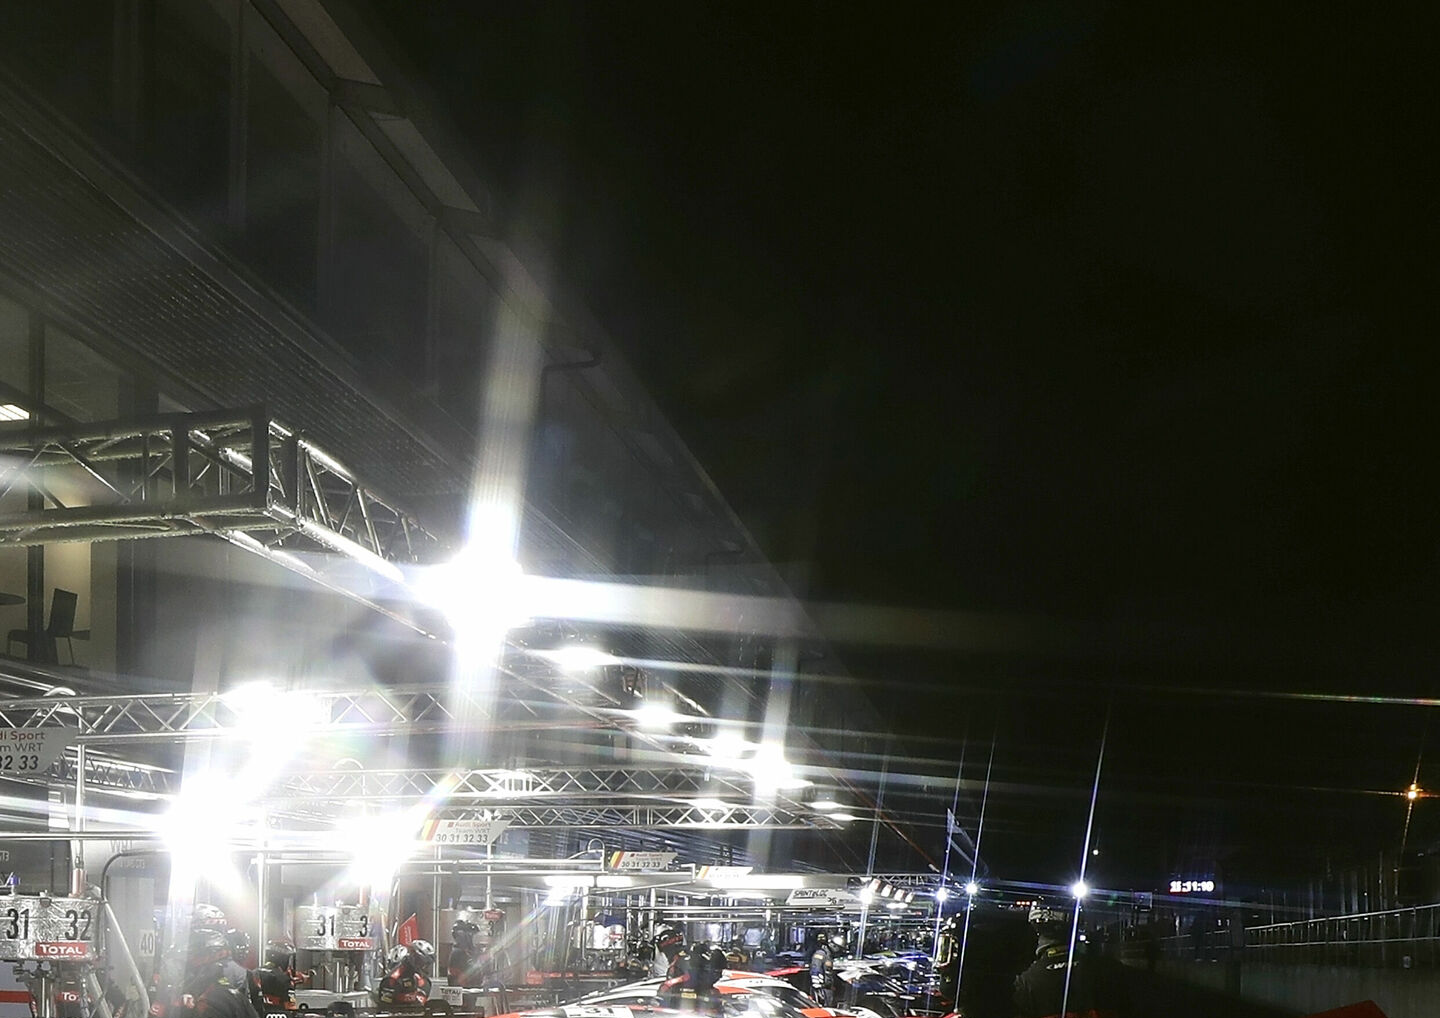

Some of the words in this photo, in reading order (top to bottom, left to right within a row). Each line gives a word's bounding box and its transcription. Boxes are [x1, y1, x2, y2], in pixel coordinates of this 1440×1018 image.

[10, 730, 45, 742] Sport
[14, 743, 43, 752] WRT
[18, 754, 38, 770] 33
[6, 907, 30, 940] 31
[64, 909, 91, 940] 32
[317, 914, 335, 937] 31
[40, 944, 83, 955] TOTAL
[139, 933, 154, 955] 40
[342, 940, 369, 948] TOTAL
